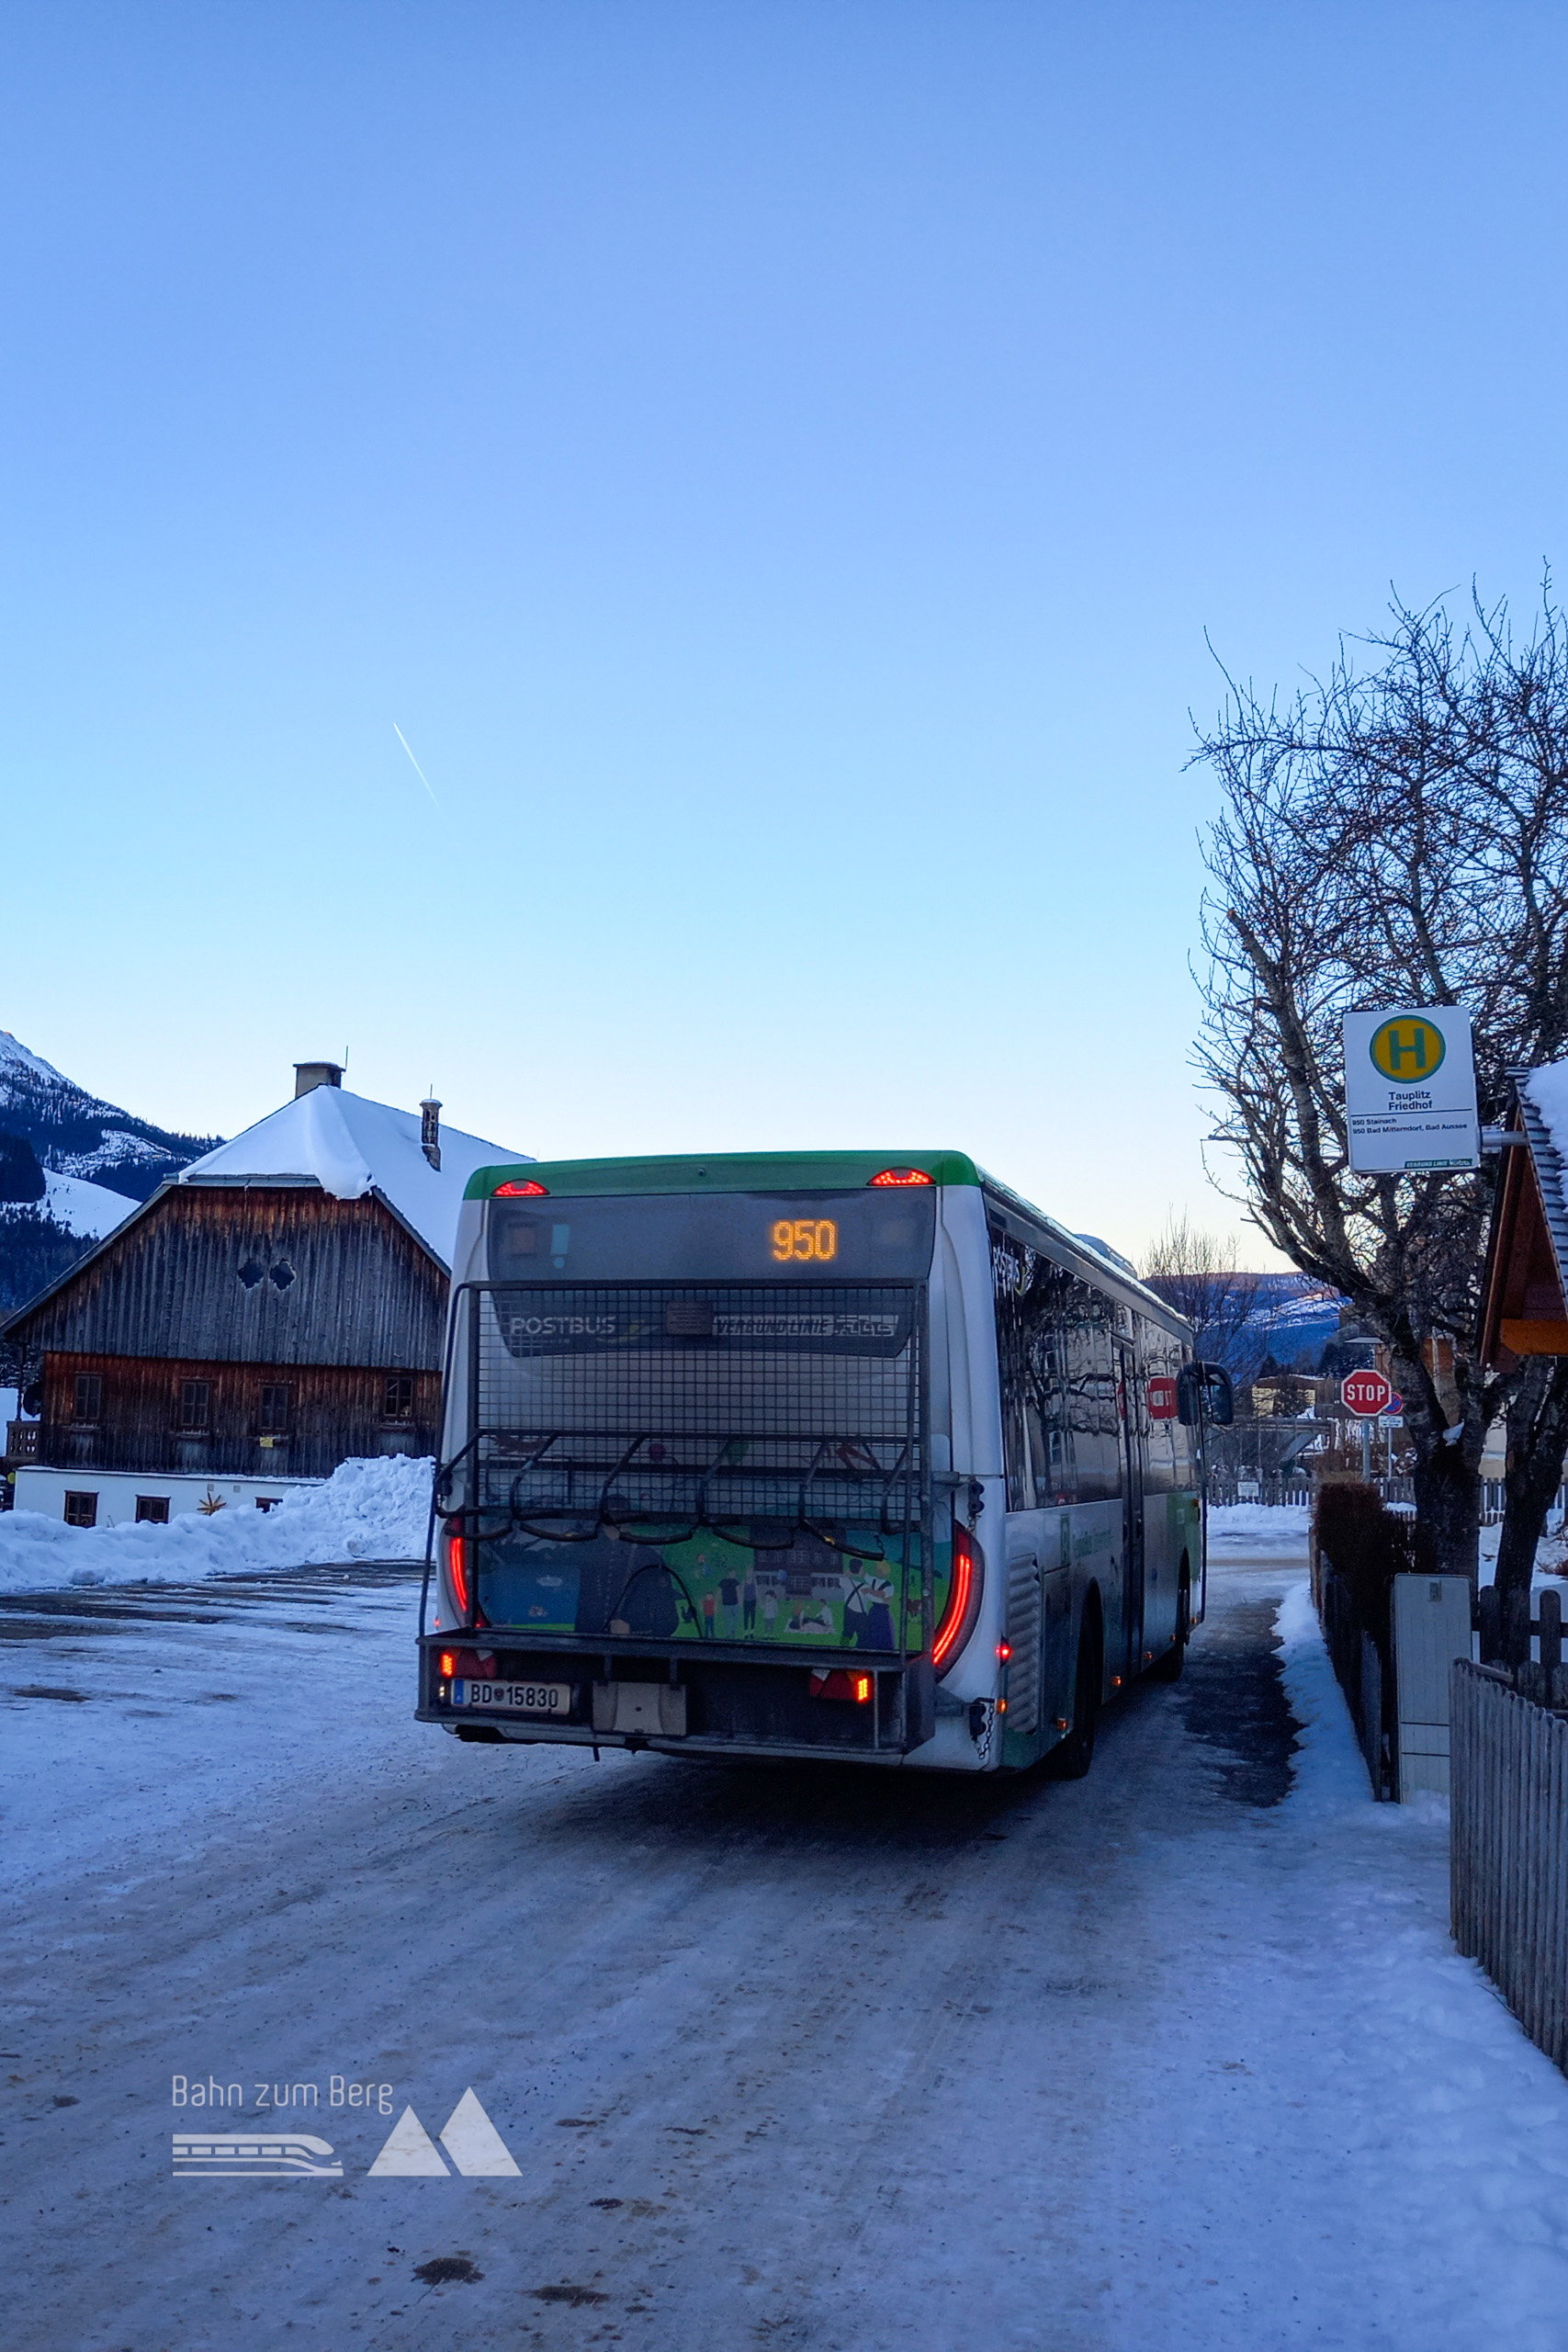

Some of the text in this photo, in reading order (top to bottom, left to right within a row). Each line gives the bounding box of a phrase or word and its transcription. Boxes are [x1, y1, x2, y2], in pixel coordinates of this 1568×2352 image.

[1388, 1027, 1427, 1070] H
[1388, 1091, 1431, 1102] Tauplitz
[1388, 1100, 1433, 1111] Friedhof
[1382, 1125, 1425, 1133] Mitterndorf,
[772, 1220, 837, 1261] 950
[511, 1316, 616, 1335] POSTBUS
[1347, 1385, 1385, 1401] STOP
[470, 1684, 558, 1708] BD 15830
